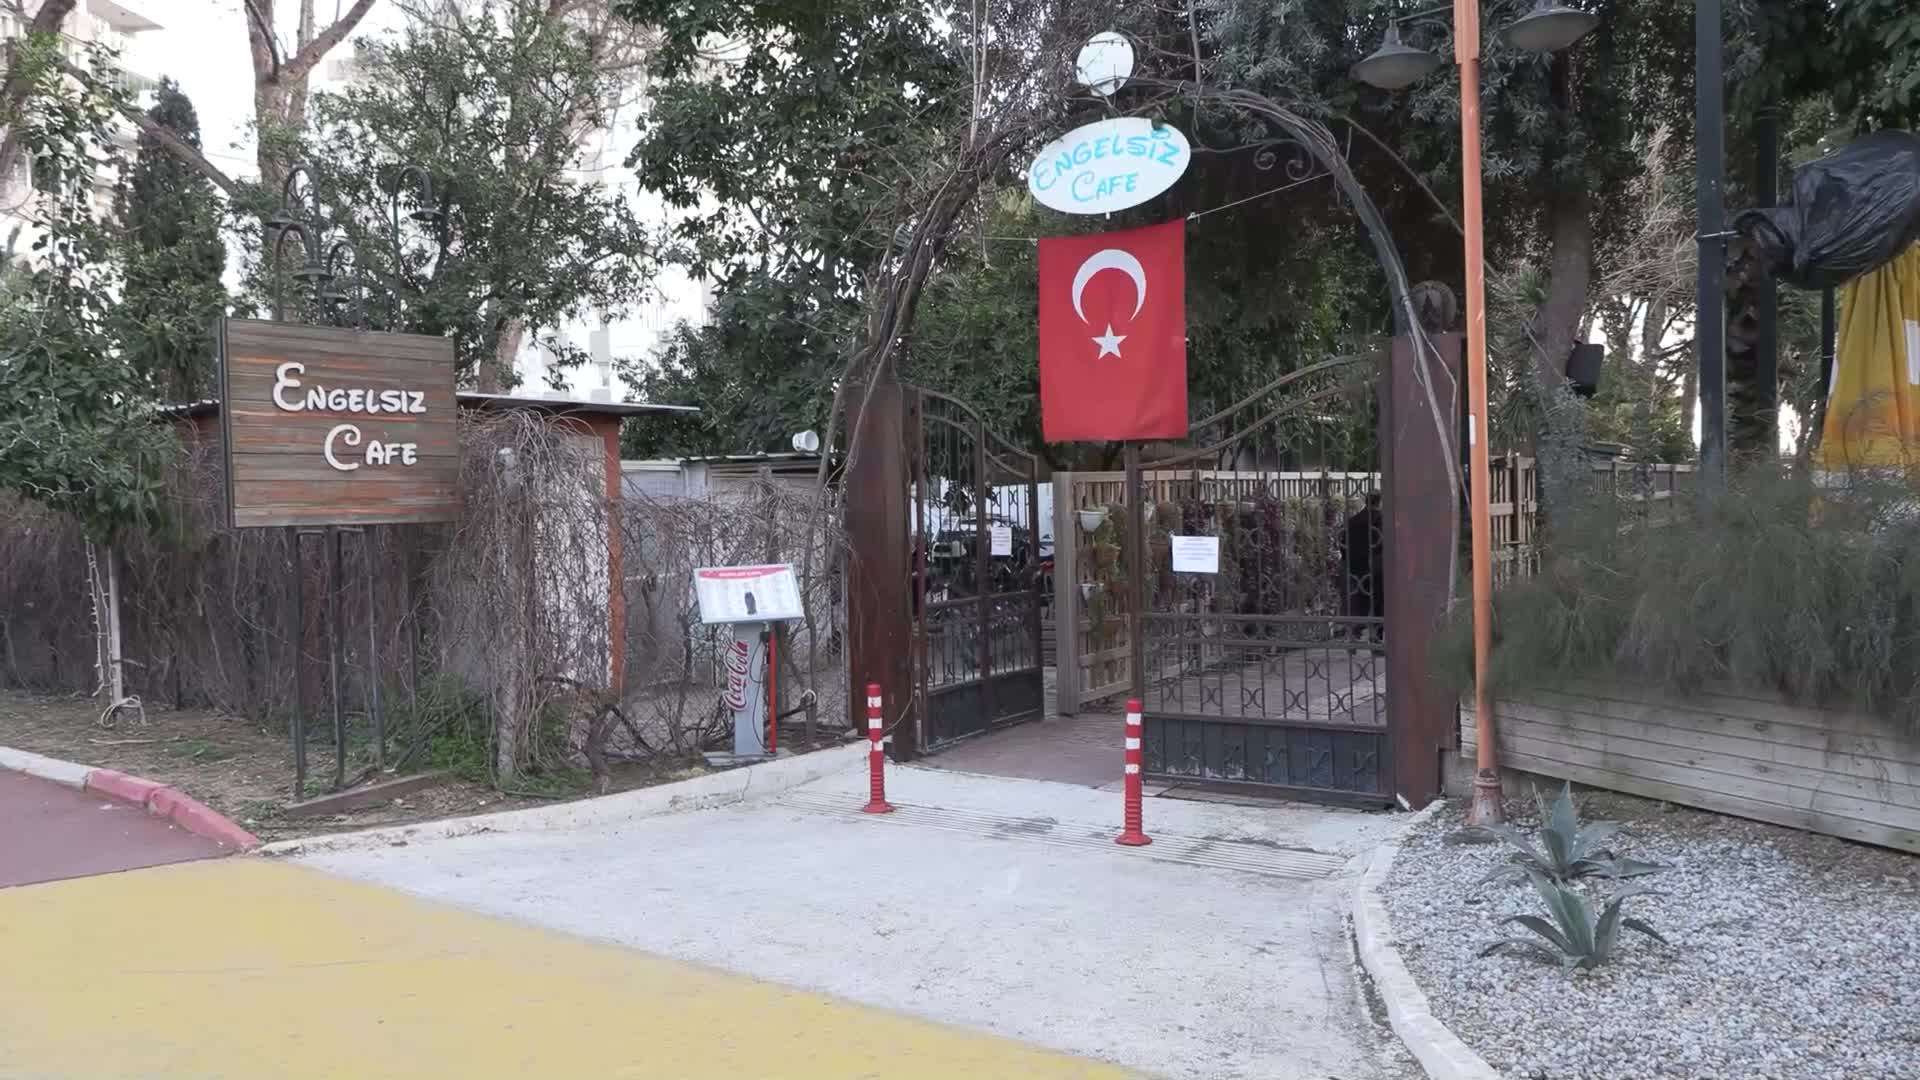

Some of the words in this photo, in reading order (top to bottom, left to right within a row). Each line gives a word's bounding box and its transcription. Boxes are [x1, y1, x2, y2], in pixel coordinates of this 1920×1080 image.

[1072, 170, 1139, 202] CAFE
[273, 362, 426, 413] ENGELSIZ
[324, 424, 417, 471] CAFE
